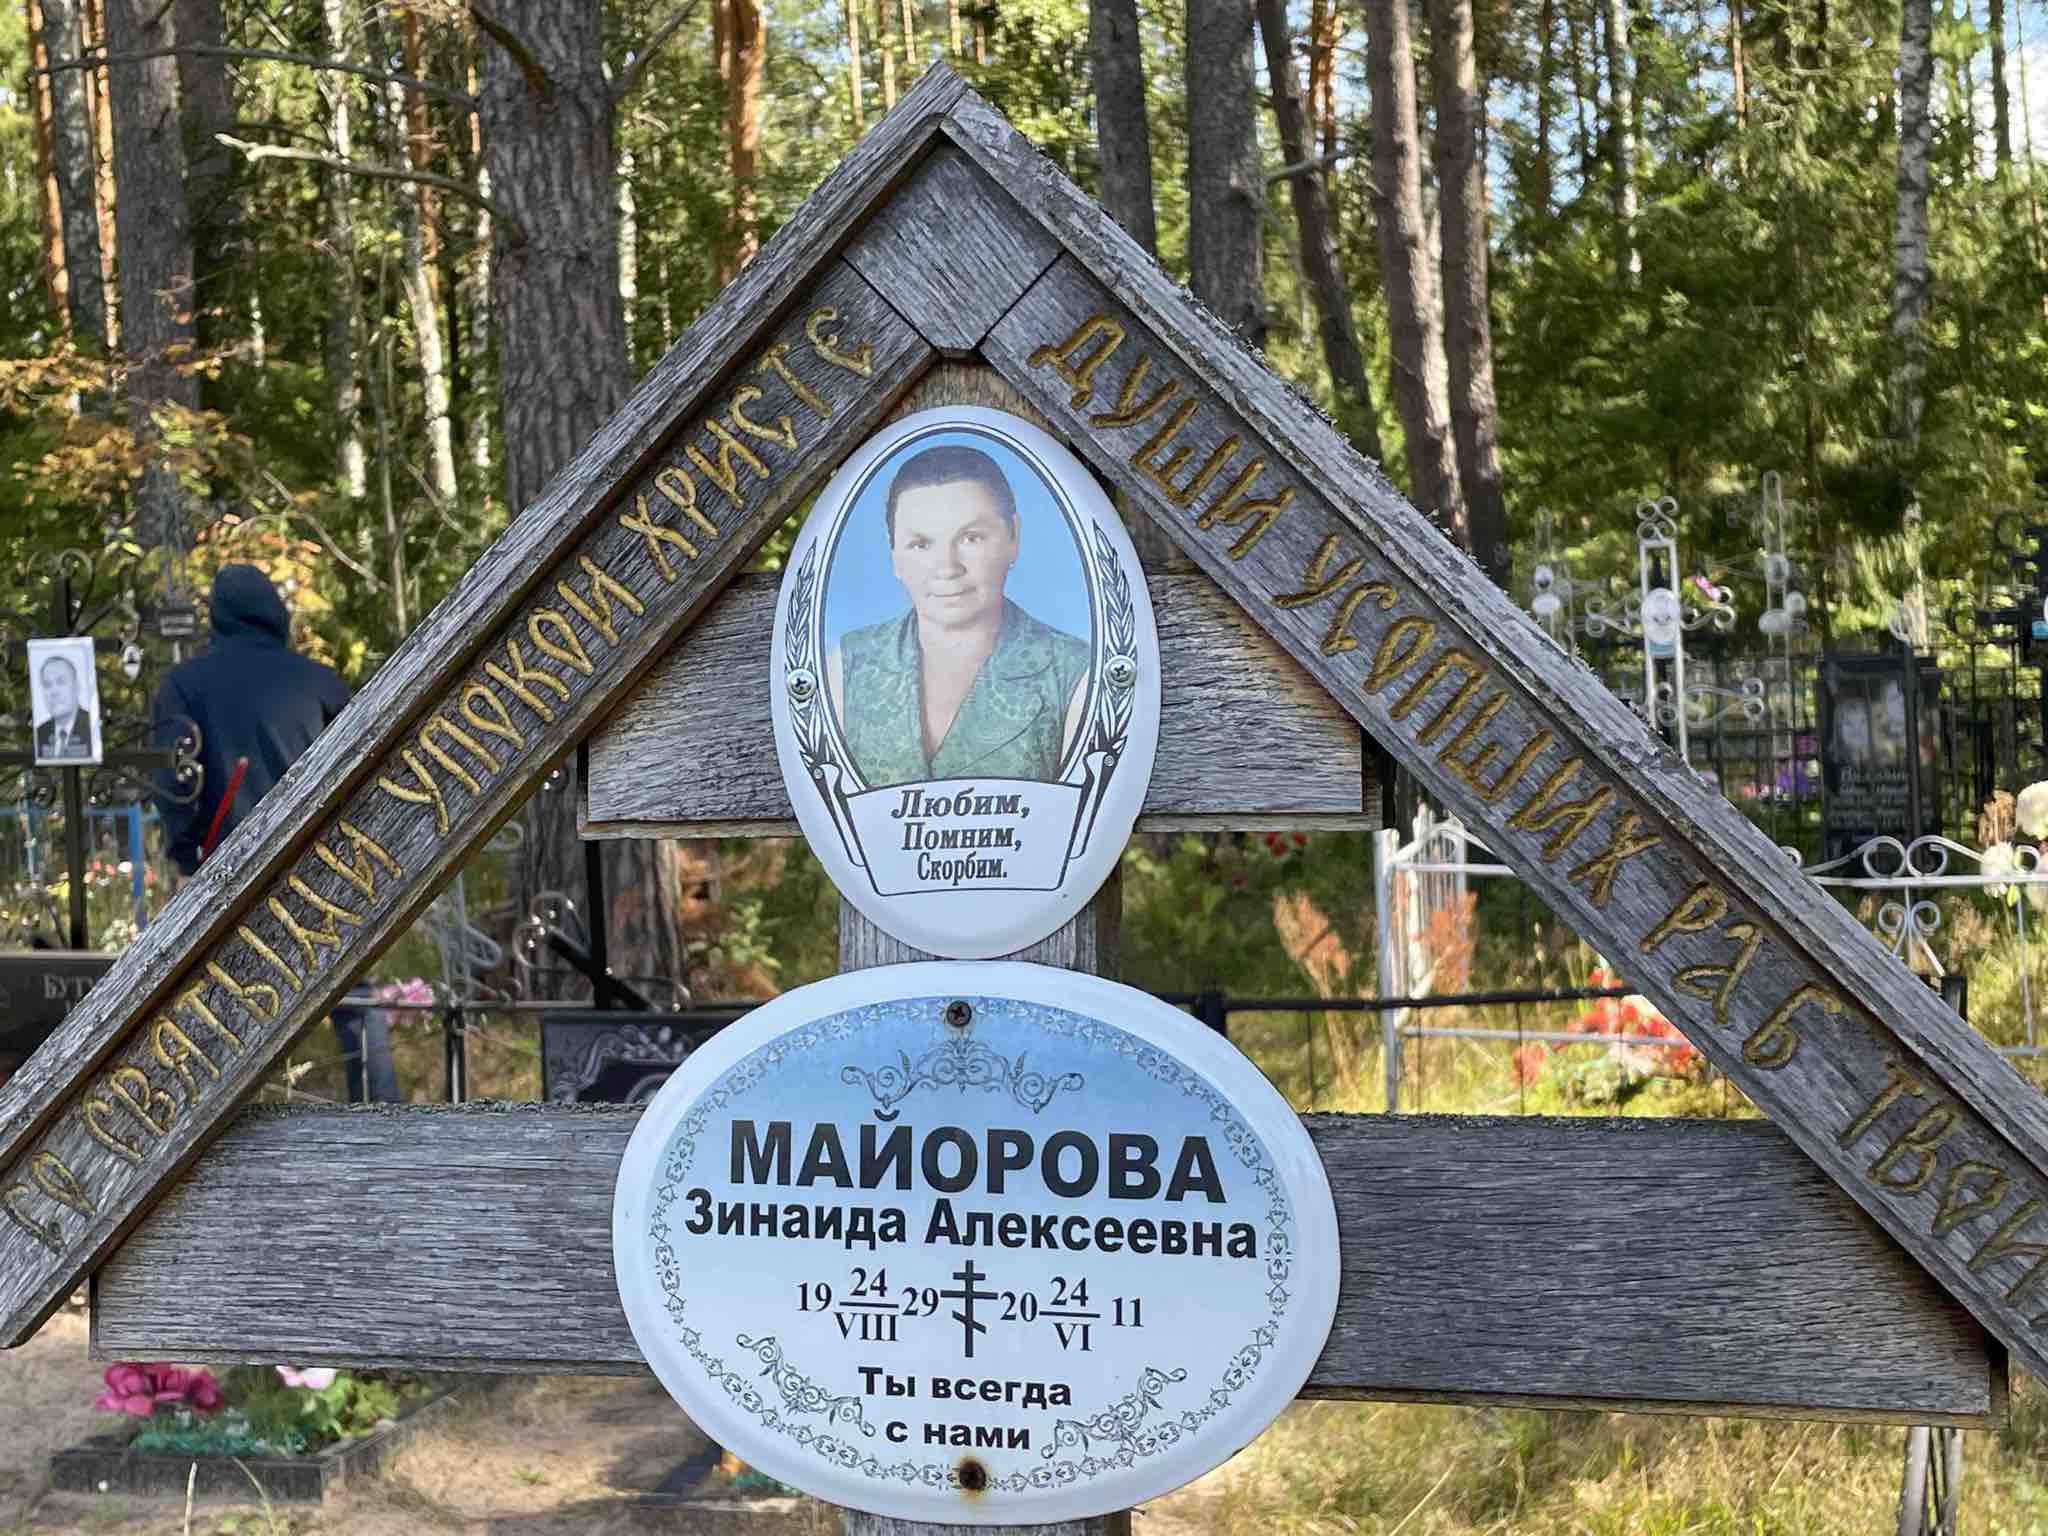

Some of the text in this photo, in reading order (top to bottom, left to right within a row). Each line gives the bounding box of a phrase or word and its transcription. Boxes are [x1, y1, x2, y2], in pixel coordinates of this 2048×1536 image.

[1028, 313, 1297, 560] ДУШИ
[1271, 534, 1664, 907] УСОПШИХ
[84, 820, 402, 1161] СВЯТЫМИ
[618, 306, 873, 582] ХРИСТЕ
[891, 787, 1030, 818] Любим,
[901, 822, 1021, 851] Помним,
[918, 851, 1007, 886] Скорбим.
[730, 1109, 1227, 1204] МАЙОРОВА
[685, 1187, 1256, 1258] Зинаида Алексеевна
[798, 1268, 938, 1341] 19 24 VIII 29
[1000, 1277, 1144, 1351] 20 24 VI 11
[858, 1366, 1071, 1410] Ты всегда
[886, 1422, 1029, 1449] с нами
